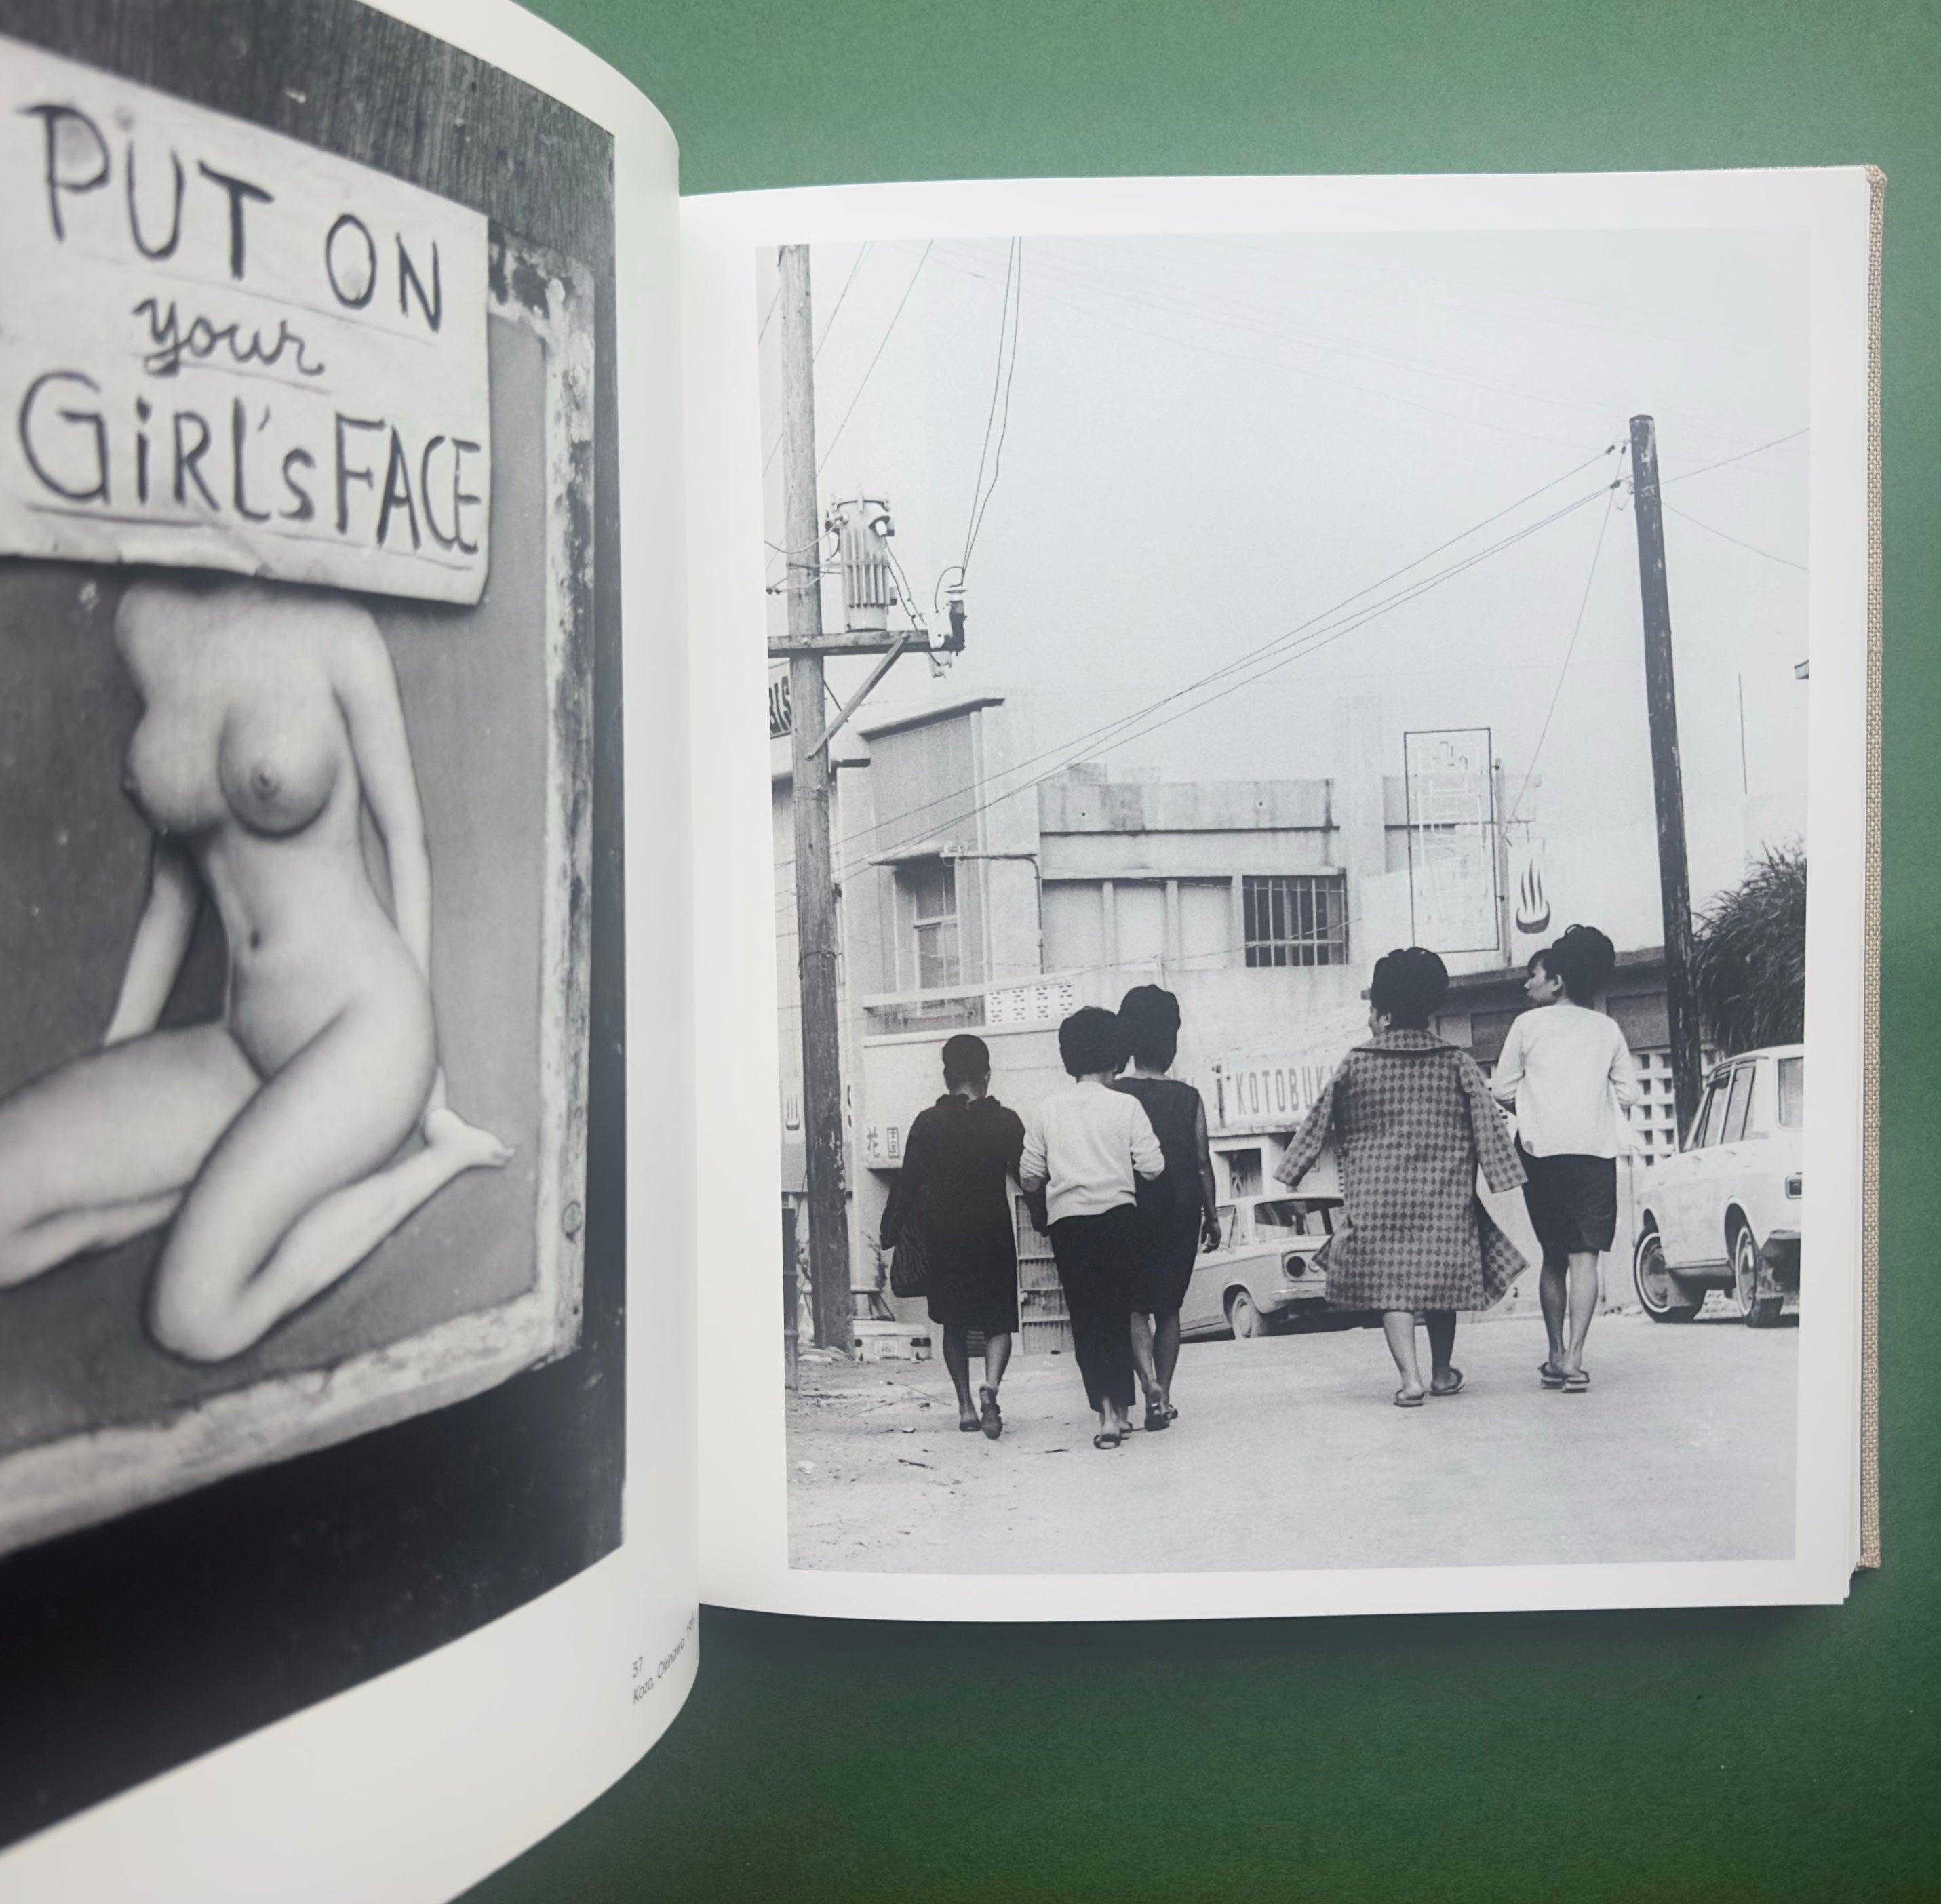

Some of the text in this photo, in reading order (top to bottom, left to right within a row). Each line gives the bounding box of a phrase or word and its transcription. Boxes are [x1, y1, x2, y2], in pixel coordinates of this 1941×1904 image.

[17, 104, 442, 333] PUT ON
[132, 297, 325, 377] your
[336, 412, 482, 554] FACE
[1236, 1064, 1335, 1115] KOTOBUK
